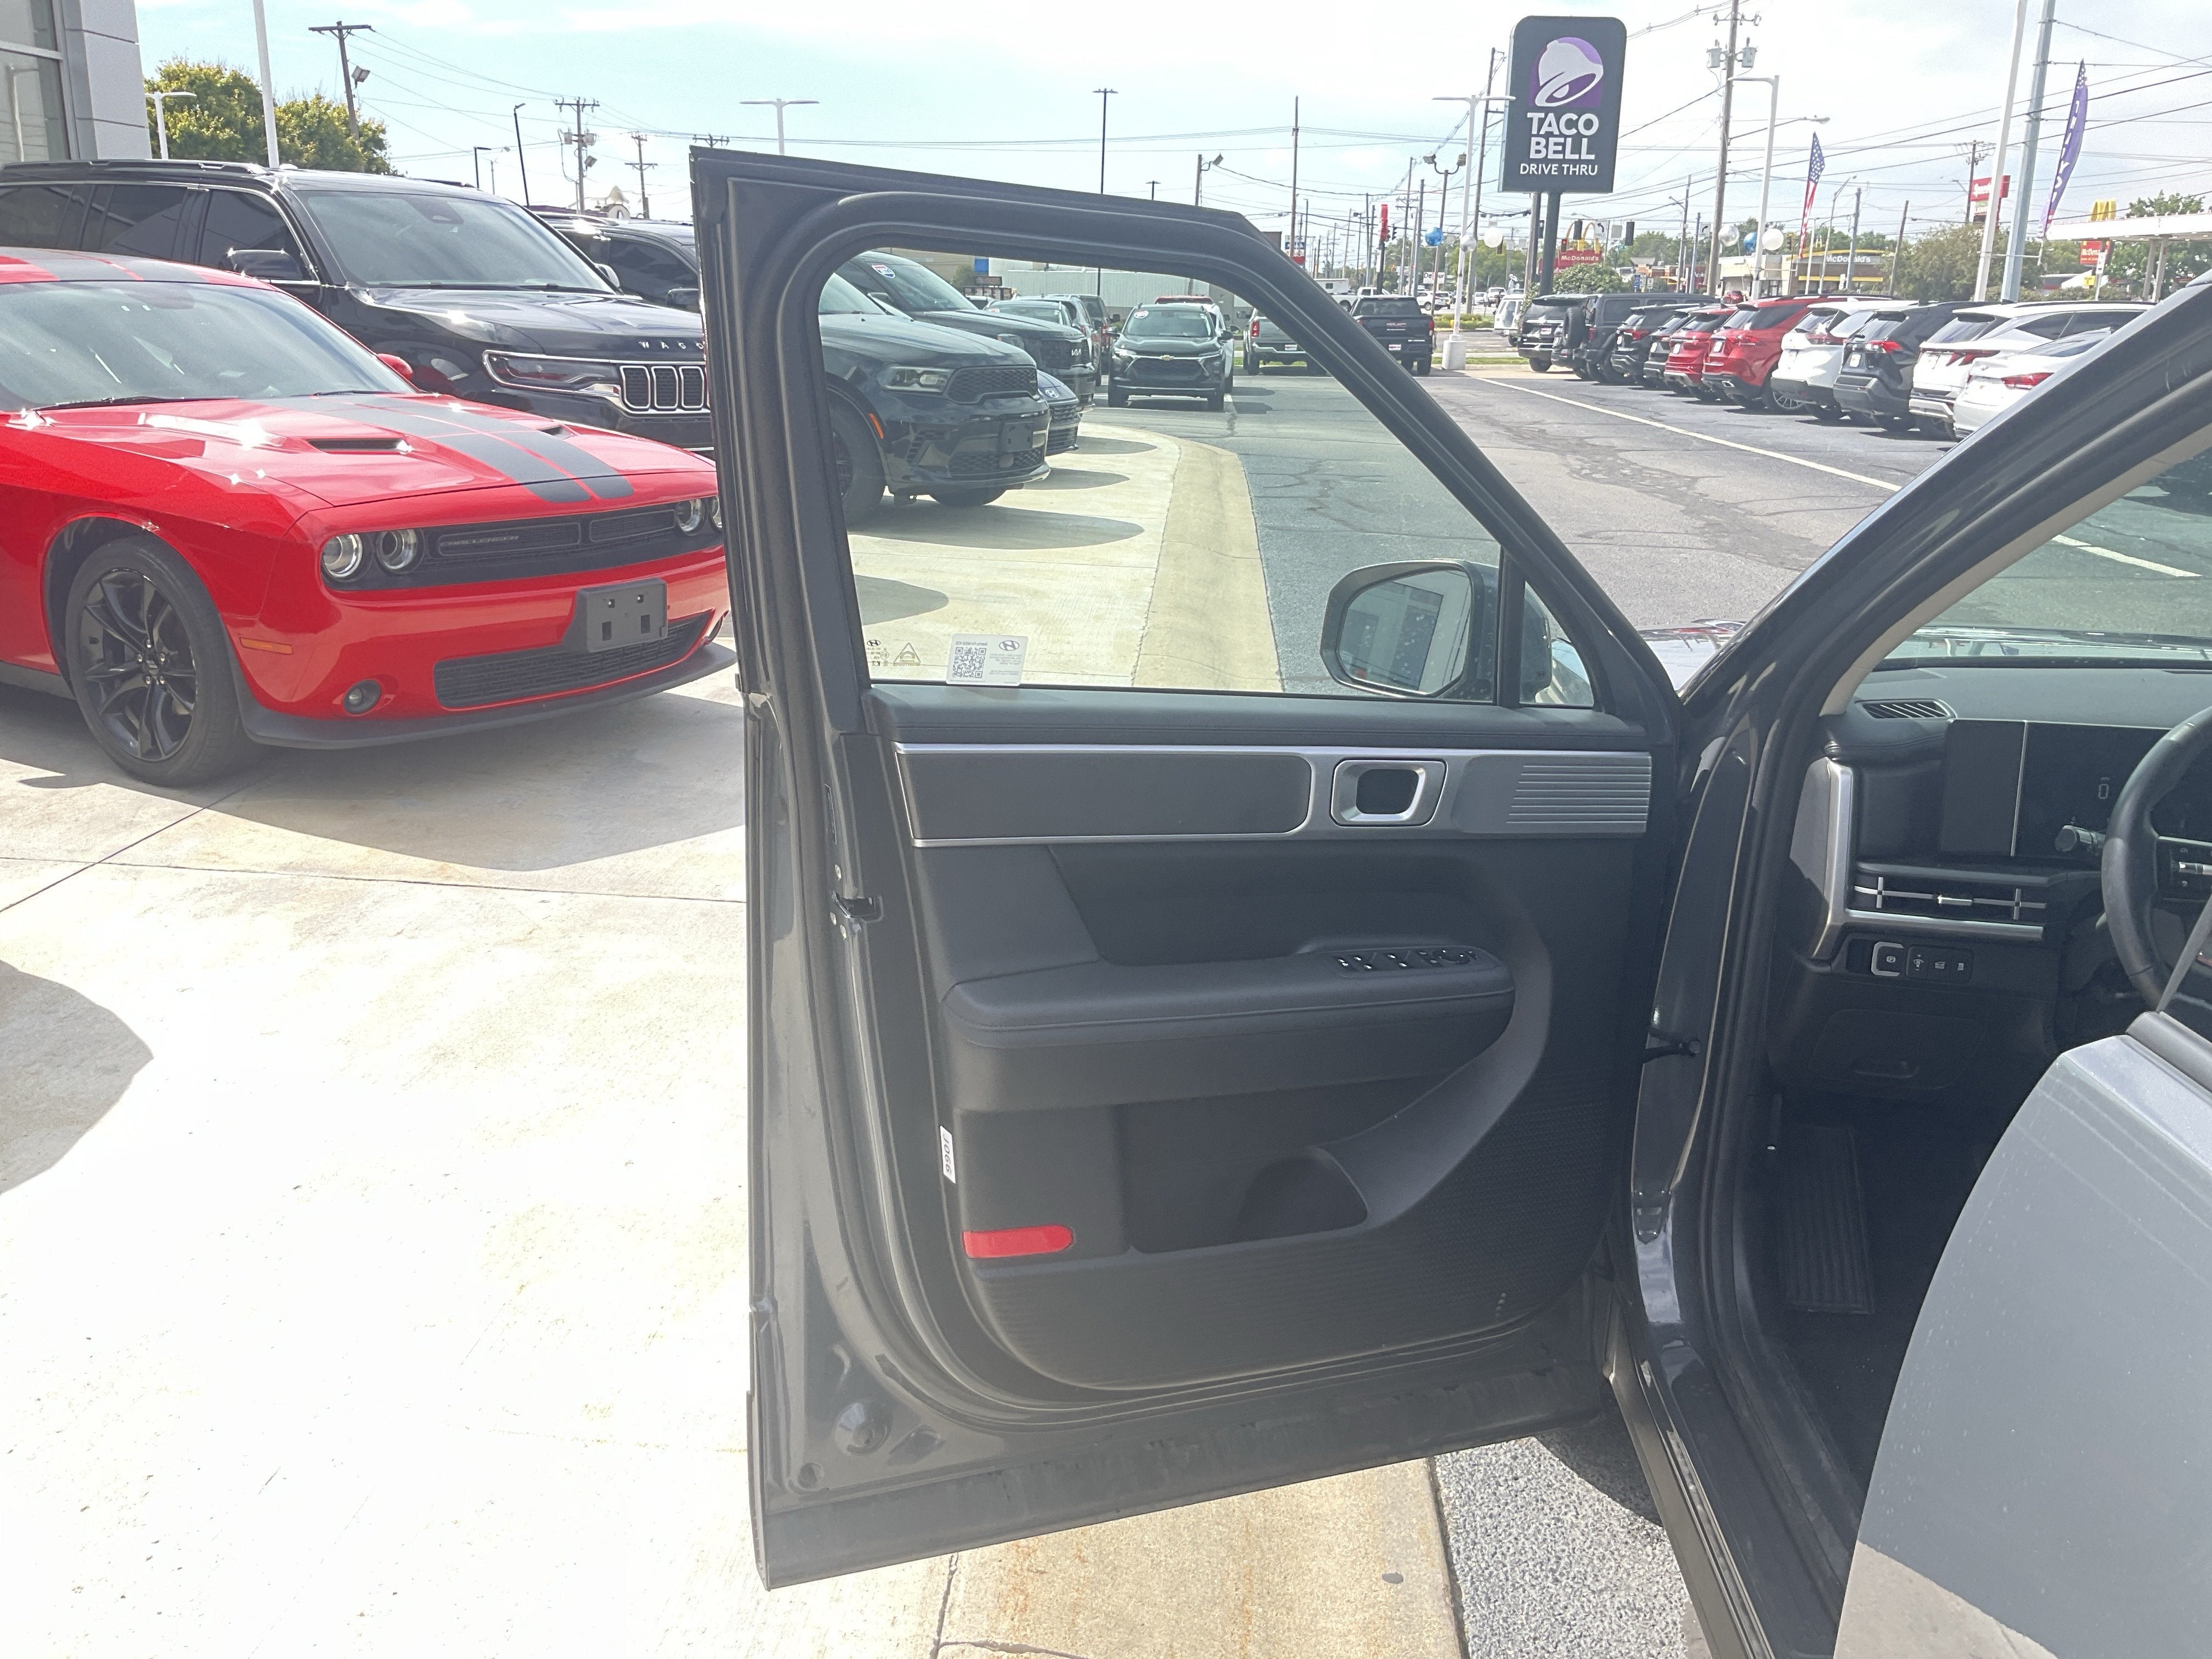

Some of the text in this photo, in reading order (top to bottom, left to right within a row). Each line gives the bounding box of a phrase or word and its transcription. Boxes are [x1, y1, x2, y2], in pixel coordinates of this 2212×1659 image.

[1527, 112, 1599, 136] TACO
[1530, 137, 1595, 160] BELL
[1520, 163, 1598, 176] DRIVE THRU
[1826, 253, 1871, 263] McDoald's
[638, 341, 704, 349] WAGO
